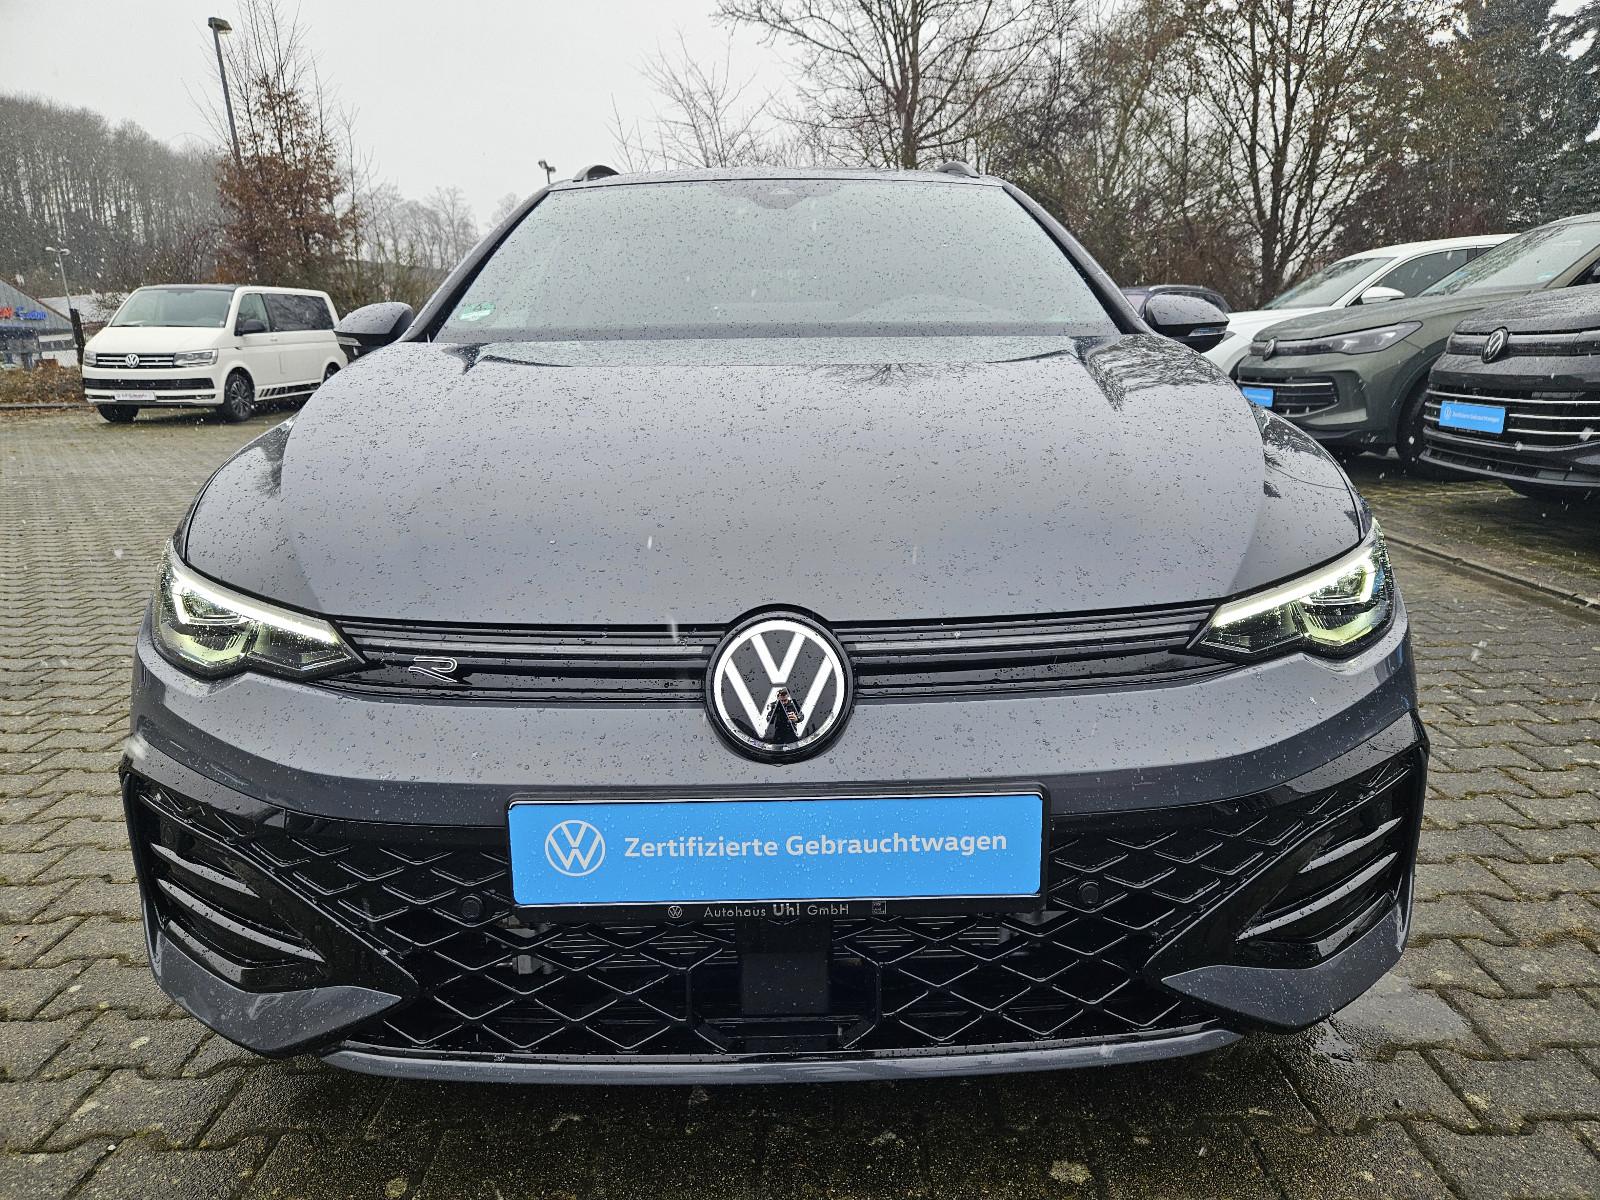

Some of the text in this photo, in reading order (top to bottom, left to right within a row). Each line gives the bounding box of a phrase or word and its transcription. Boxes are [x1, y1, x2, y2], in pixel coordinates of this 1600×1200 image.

[624, 835, 778, 858] Zertifizierte
[785, 832, 1007, 857] Gebrauchtwagen
[703, 905, 767, 919] Autohaus
[772, 903, 800, 916] Uhl
[807, 903, 849, 916] GmbH
